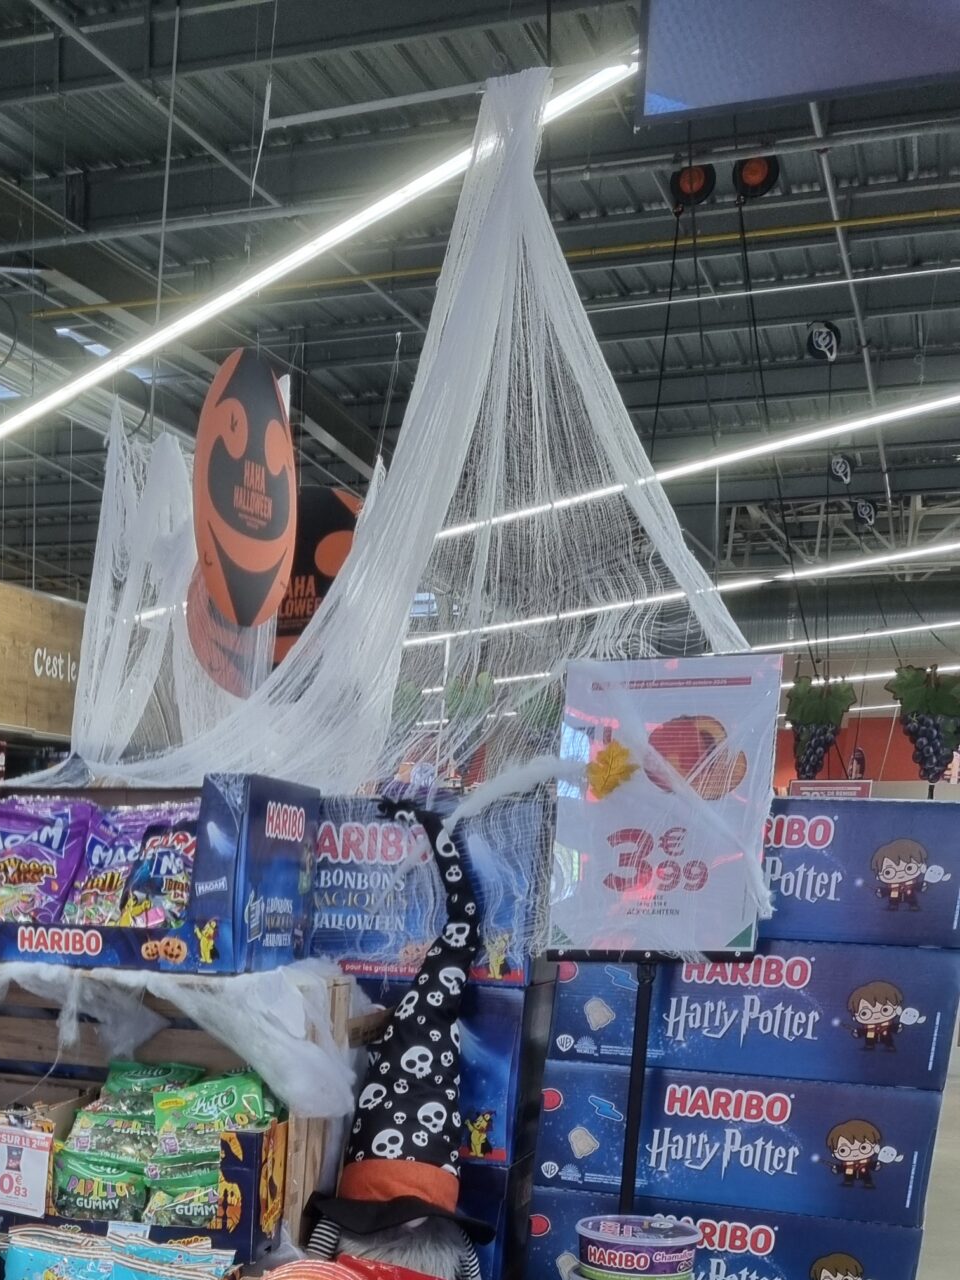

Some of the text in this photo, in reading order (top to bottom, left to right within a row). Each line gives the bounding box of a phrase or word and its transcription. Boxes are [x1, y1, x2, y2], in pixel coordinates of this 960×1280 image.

[243, 461, 266, 490] HAHA
[33, 647, 77, 683] C'est le
[265, 801, 306, 843] HARIBO
[198, 880, 226, 893] MAOAM
[765, 856, 842, 903] Potter
[17, 927, 104, 957] HARIBO
[345, 964, 361, 972] pour
[681, 956, 812, 990] HARIBO
[662, 995, 820, 1047] Harry Potter
[664, 1085, 792, 1125] HARIBO
[1, 1134, 20, 1144] SUR
[21, 1138, 30, 1146] LE
[645, 1127, 800, 1179] Harry Potter
[76, 1197, 120, 1209] GUMMY
[588, 1245, 650, 1270] HARIBO
